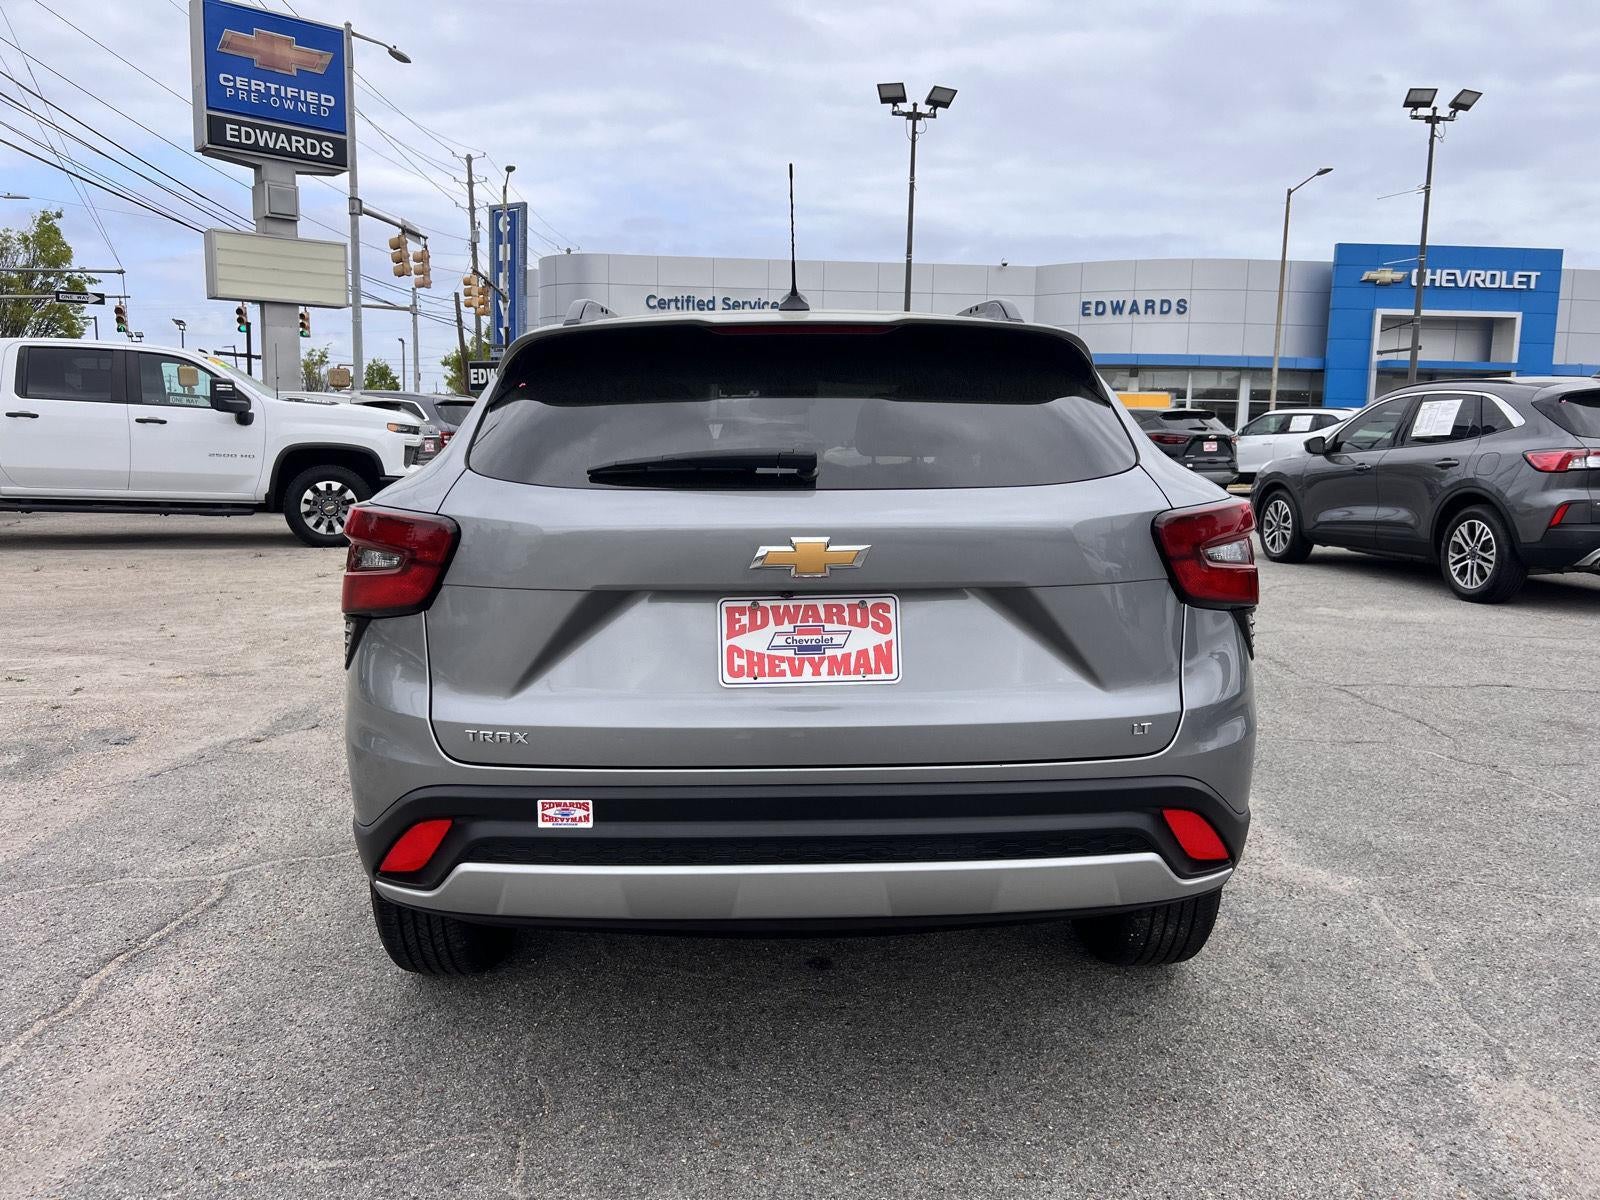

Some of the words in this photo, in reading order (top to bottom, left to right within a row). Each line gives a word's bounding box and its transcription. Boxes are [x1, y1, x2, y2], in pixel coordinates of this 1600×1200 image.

[218, 73, 335, 107] CERTIFIED
[226, 87, 329, 117] PRE-OWNED
[225, 123, 334, 158] EDWARDS
[1411, 268, 1541, 290] CHEVROLET
[645, 294, 716, 312] Certified
[722, 296, 780, 311] Service
[1081, 298, 1188, 317] EDWARDS
[725, 602, 893, 641] EDWARDS
[785, 636, 834, 645] Chevrolet
[726, 639, 893, 679] CHEVYMAN
[465, 729, 529, 744] TRAX
[1132, 722, 1152, 735] LT
[540, 801, 590, 811] EDWARDS
[541, 812, 590, 822] CHEVYMAN
